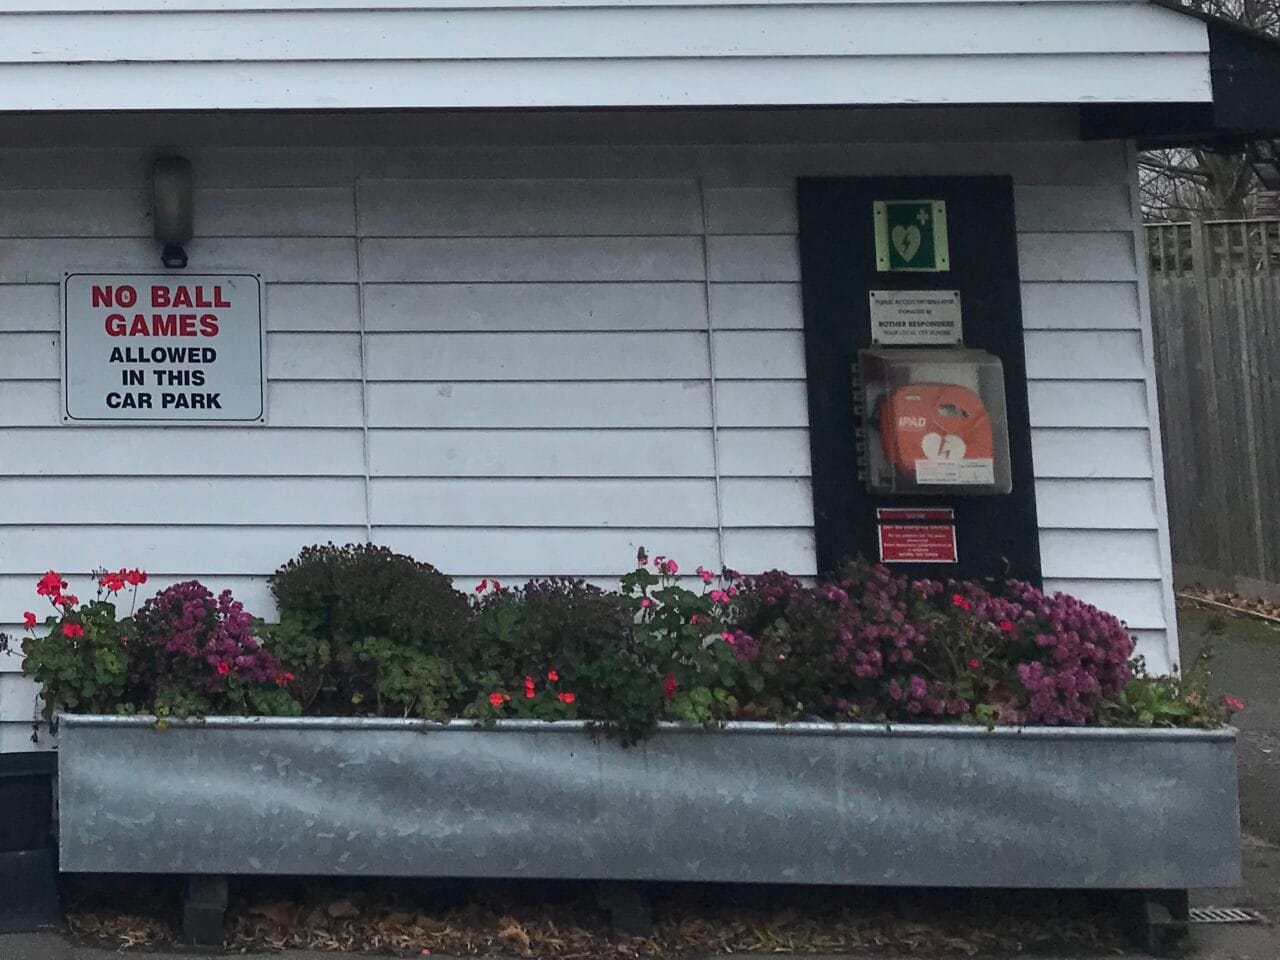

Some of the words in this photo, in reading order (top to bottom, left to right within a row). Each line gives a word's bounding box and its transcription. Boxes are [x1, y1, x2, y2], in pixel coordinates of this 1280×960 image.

[91, 285, 138, 308] NO
[151, 285, 231, 308] BALL
[105, 313, 219, 337] GAMES
[109, 346, 217, 364] ALLOWED
[122, 370, 144, 386] IN
[153, 370, 205, 386] THIS
[106, 392, 153, 409] CAR
[161, 393, 222, 409] PARK
